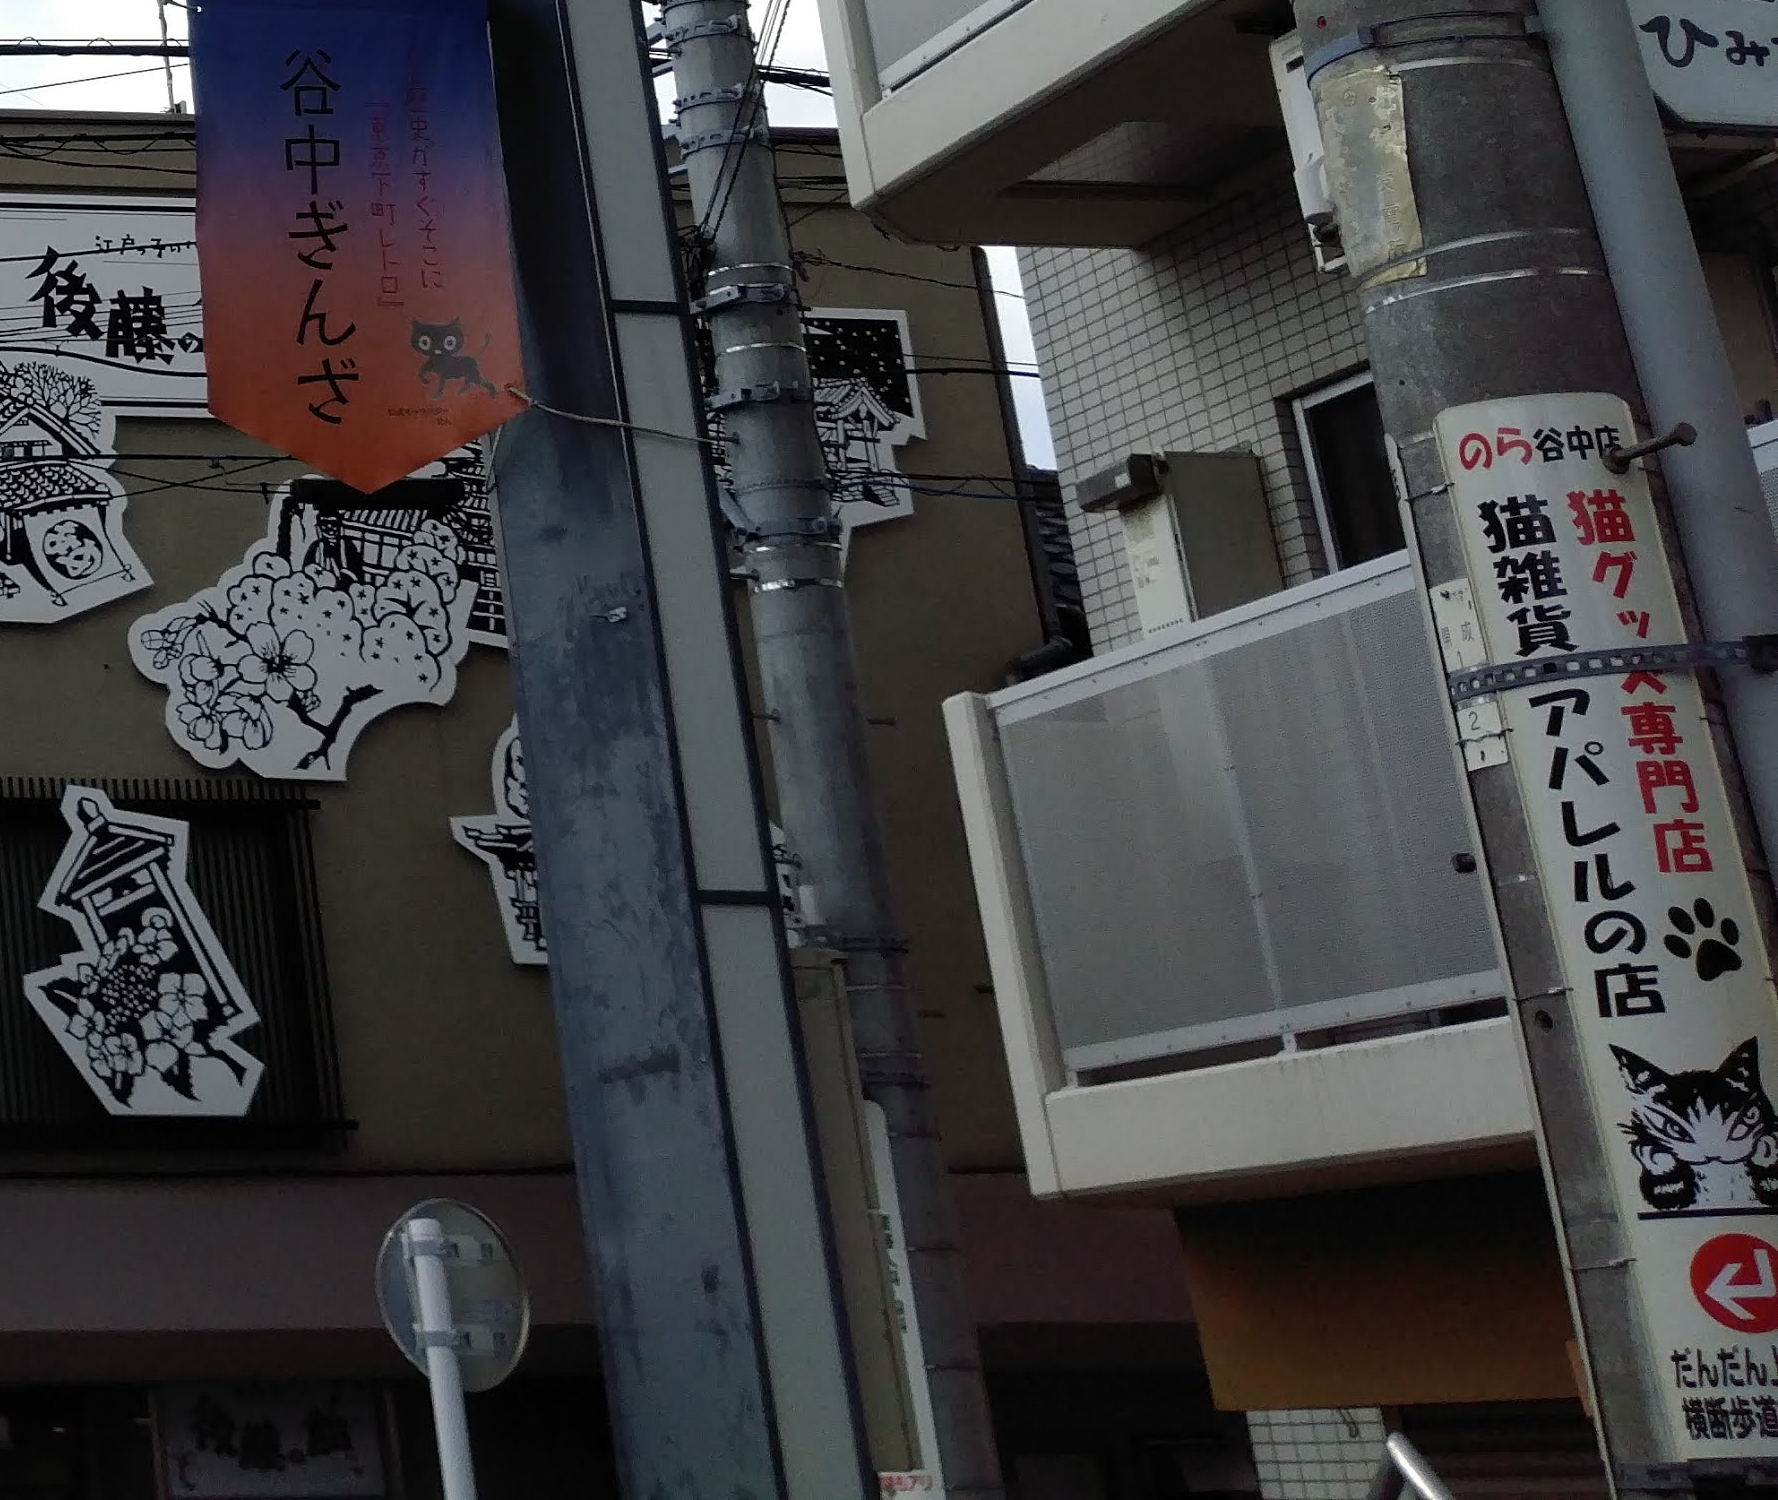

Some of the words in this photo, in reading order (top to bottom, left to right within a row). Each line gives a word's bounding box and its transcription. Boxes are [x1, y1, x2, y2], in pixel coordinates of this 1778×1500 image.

[1639, 15, 1778, 68] ひみ
[279, 49, 360, 426] 谷中ぎんざ
[25, 245, 204, 366] 後藤の
[1458, 424, 1621, 471] のら谷中店
